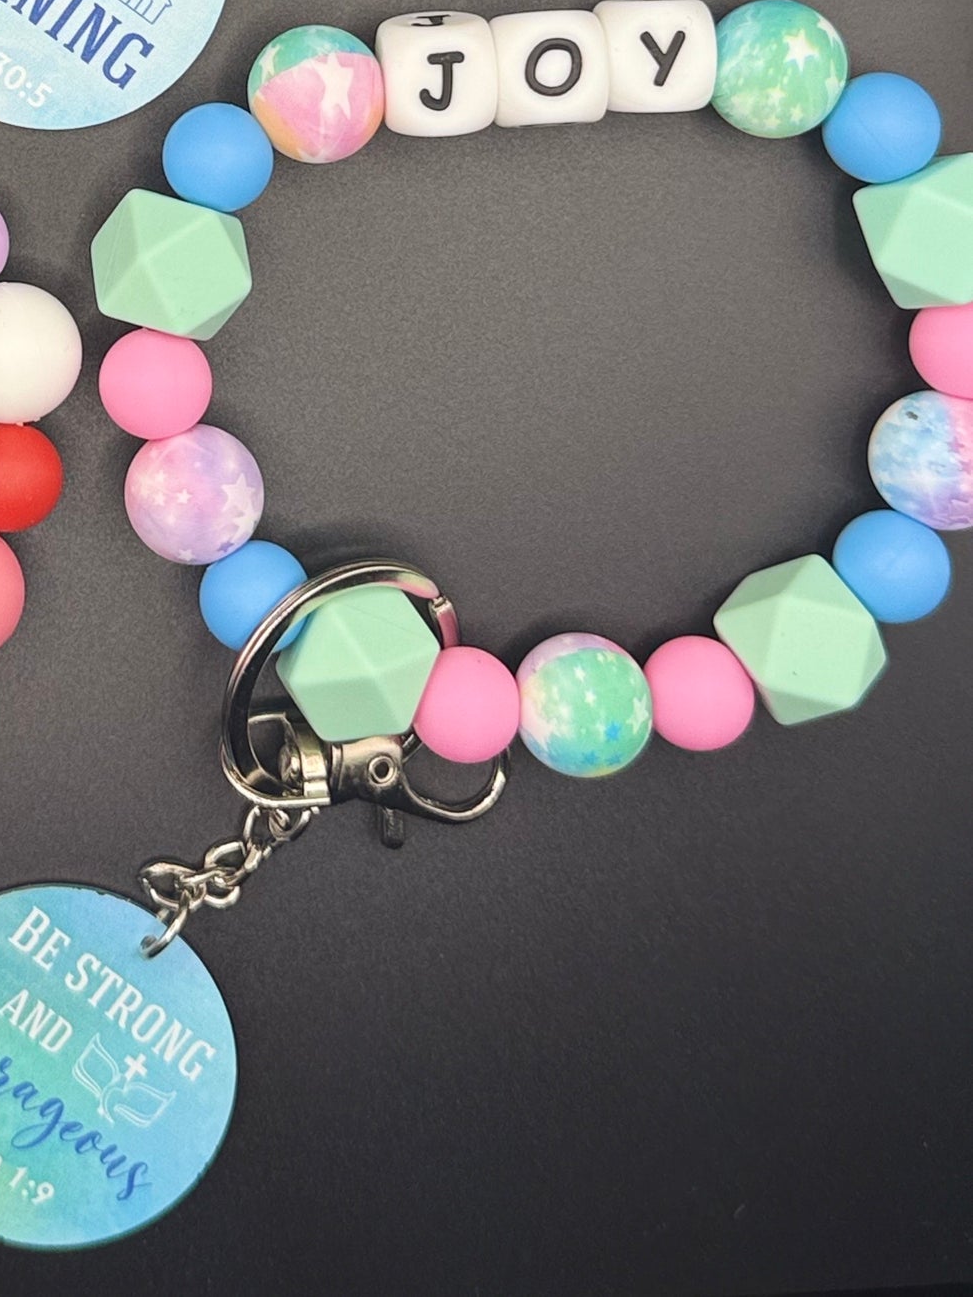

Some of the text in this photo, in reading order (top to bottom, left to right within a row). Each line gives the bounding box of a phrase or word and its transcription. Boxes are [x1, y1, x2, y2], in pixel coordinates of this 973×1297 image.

[419, 30, 686, 111] JOY
[8, 906, 216, 1082] BE STRONG
[8, 1166, 56, 1205] 1:9
